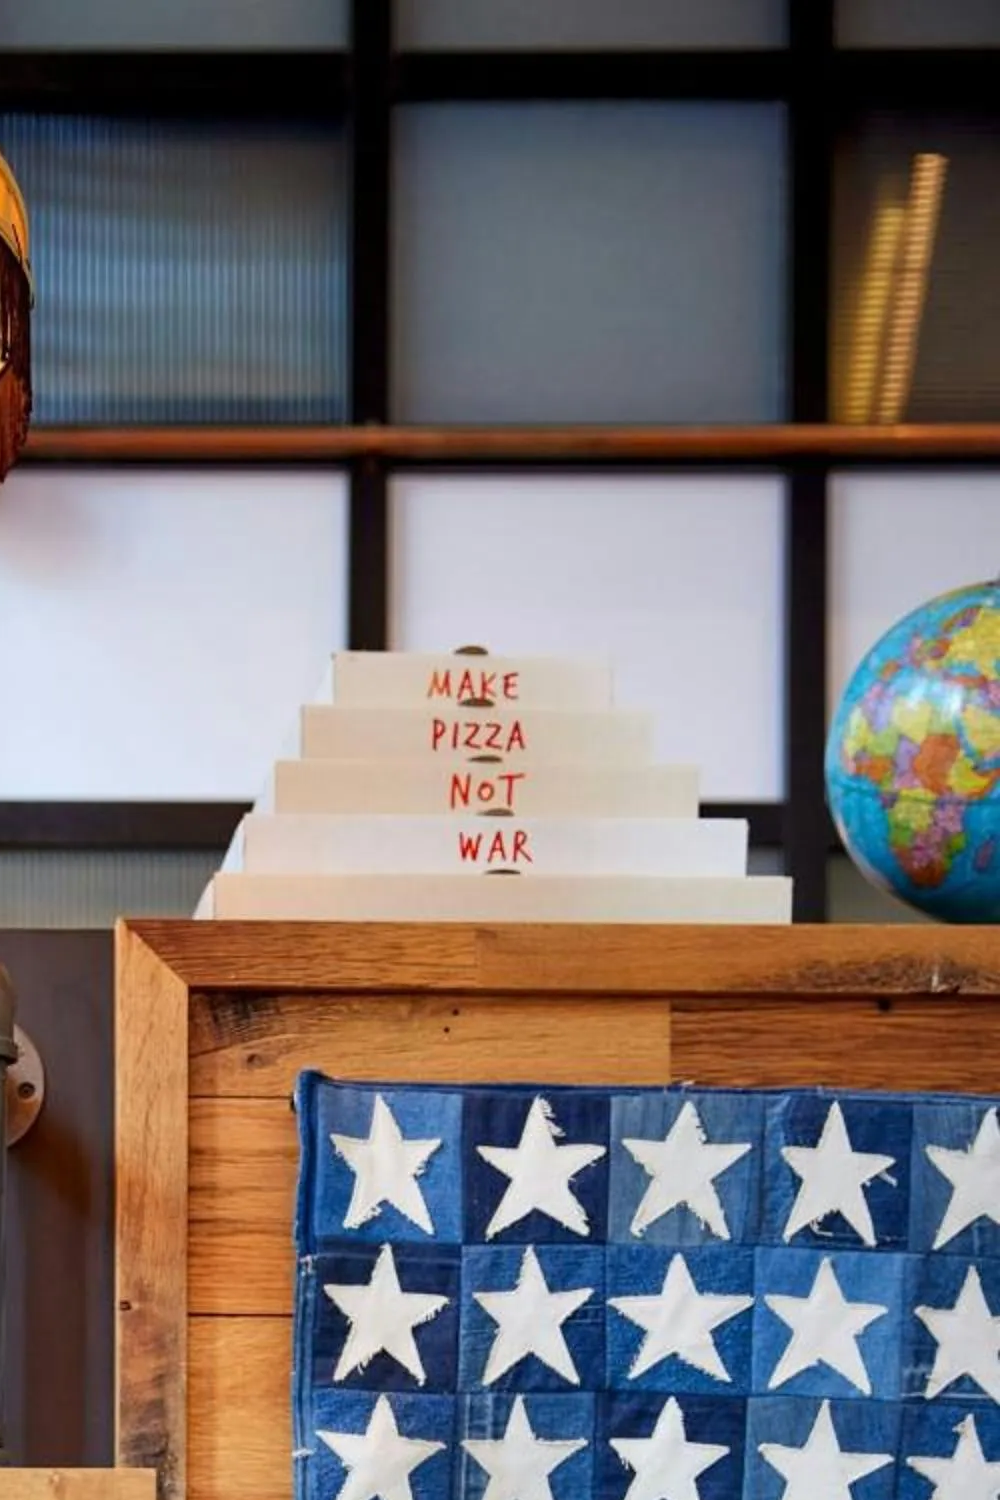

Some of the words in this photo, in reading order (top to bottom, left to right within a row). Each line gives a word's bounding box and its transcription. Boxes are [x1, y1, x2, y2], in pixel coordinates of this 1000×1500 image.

[427, 669, 520, 701] MAKE
[430, 718, 527, 753] PIZZA
[449, 772, 527, 810] NOT
[458, 829, 534, 864] WAR
